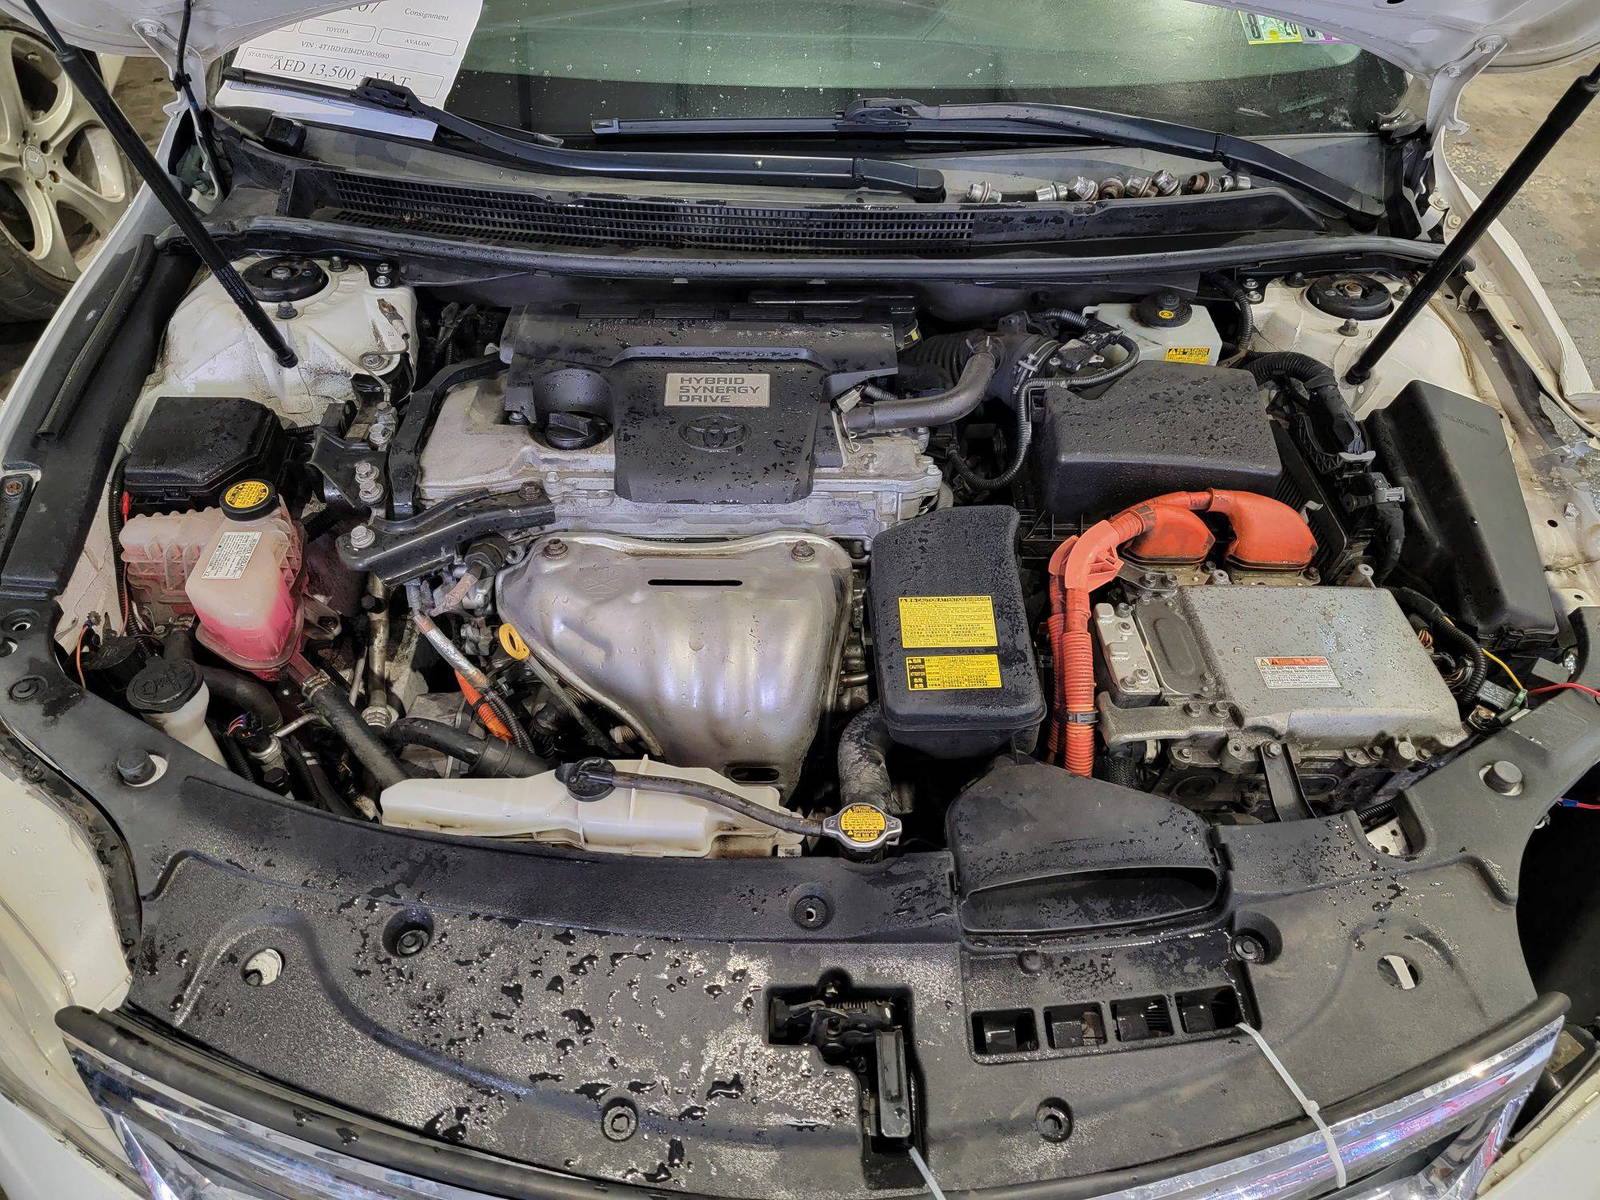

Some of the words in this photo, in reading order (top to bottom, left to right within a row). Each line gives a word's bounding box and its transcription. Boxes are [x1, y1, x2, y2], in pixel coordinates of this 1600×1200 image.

[404, 7, 449, 21] Consignment
[326, 26, 350, 34] TOYOTA
[405, 39, 431, 47] AVALON
[270, 59, 305, 73] AED
[310, 63, 356, 80] 13,500
[681, 377, 745, 385] HYBRID
[680, 386, 760, 394] SYNERGY
[679, 395, 731, 403] DRIVE
